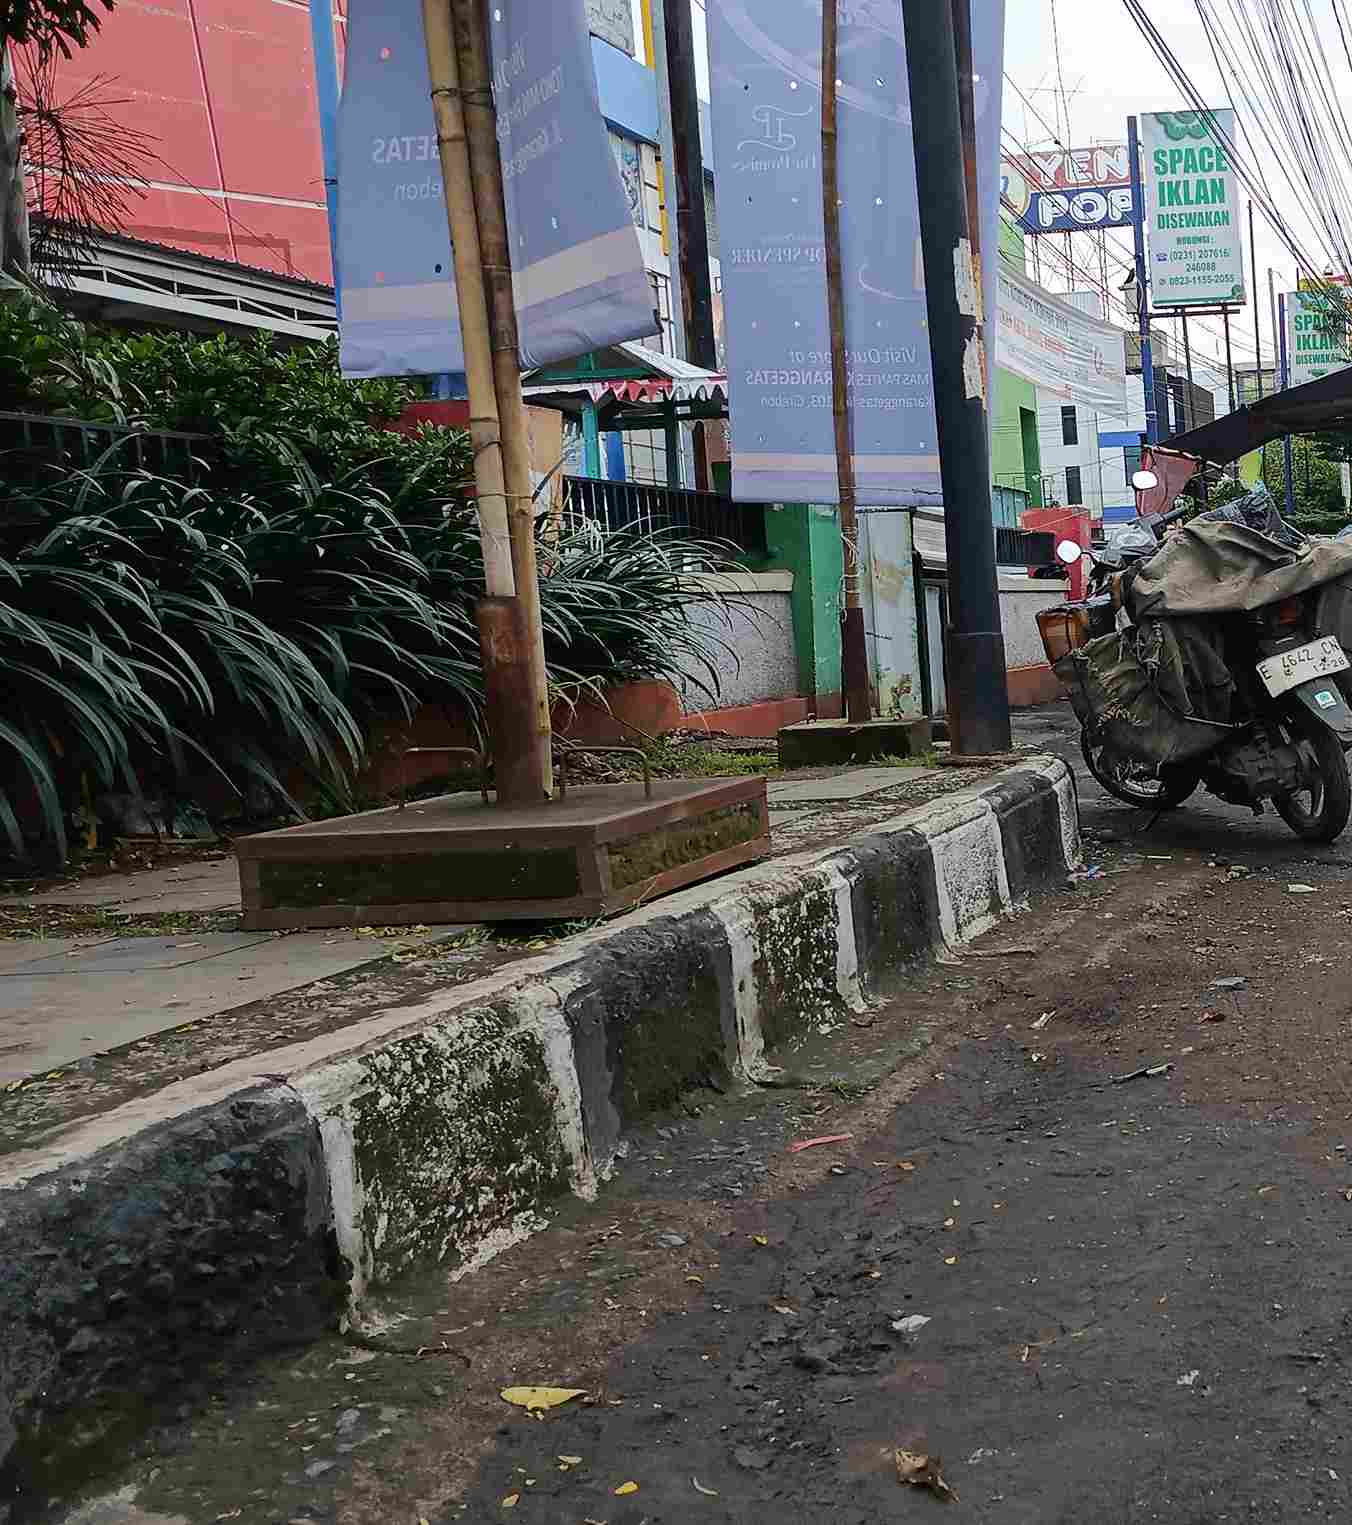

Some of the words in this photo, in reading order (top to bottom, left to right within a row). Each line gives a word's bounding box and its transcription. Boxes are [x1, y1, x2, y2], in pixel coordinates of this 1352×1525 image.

[1030, 145, 1130, 185] YEN
[1153, 146, 1229, 175] SPACE
[1039, 188, 1132, 226] POP
[1158, 178, 1224, 207] IKLAN
[1157, 210, 1230, 229] DISEWAKAN
[1259, 664, 1273, 681] E
